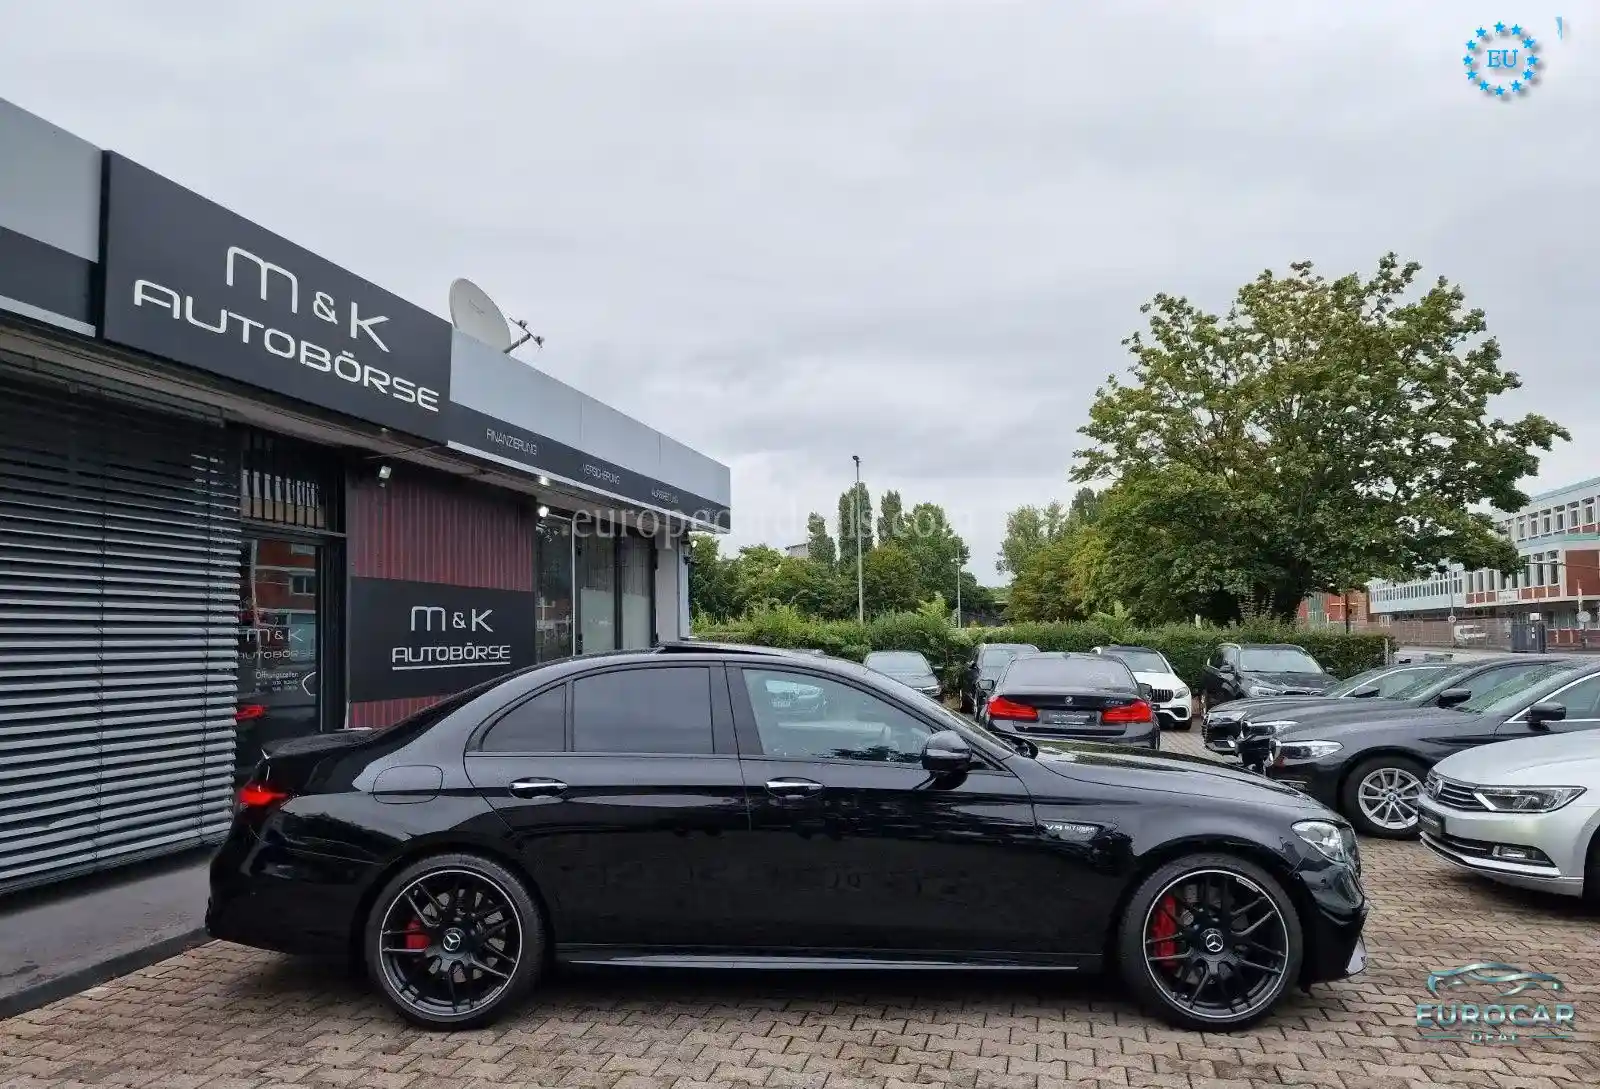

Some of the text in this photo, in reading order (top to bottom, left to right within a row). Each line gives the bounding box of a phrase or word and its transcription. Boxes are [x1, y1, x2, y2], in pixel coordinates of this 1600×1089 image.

[226, 246, 390, 353] M & K
[133, 279, 440, 412] AUTOBÖRSE
[410, 605, 494, 633] M & K
[287, 628, 304, 642] K
[392, 642, 511, 664] AUTOBÖRSE
